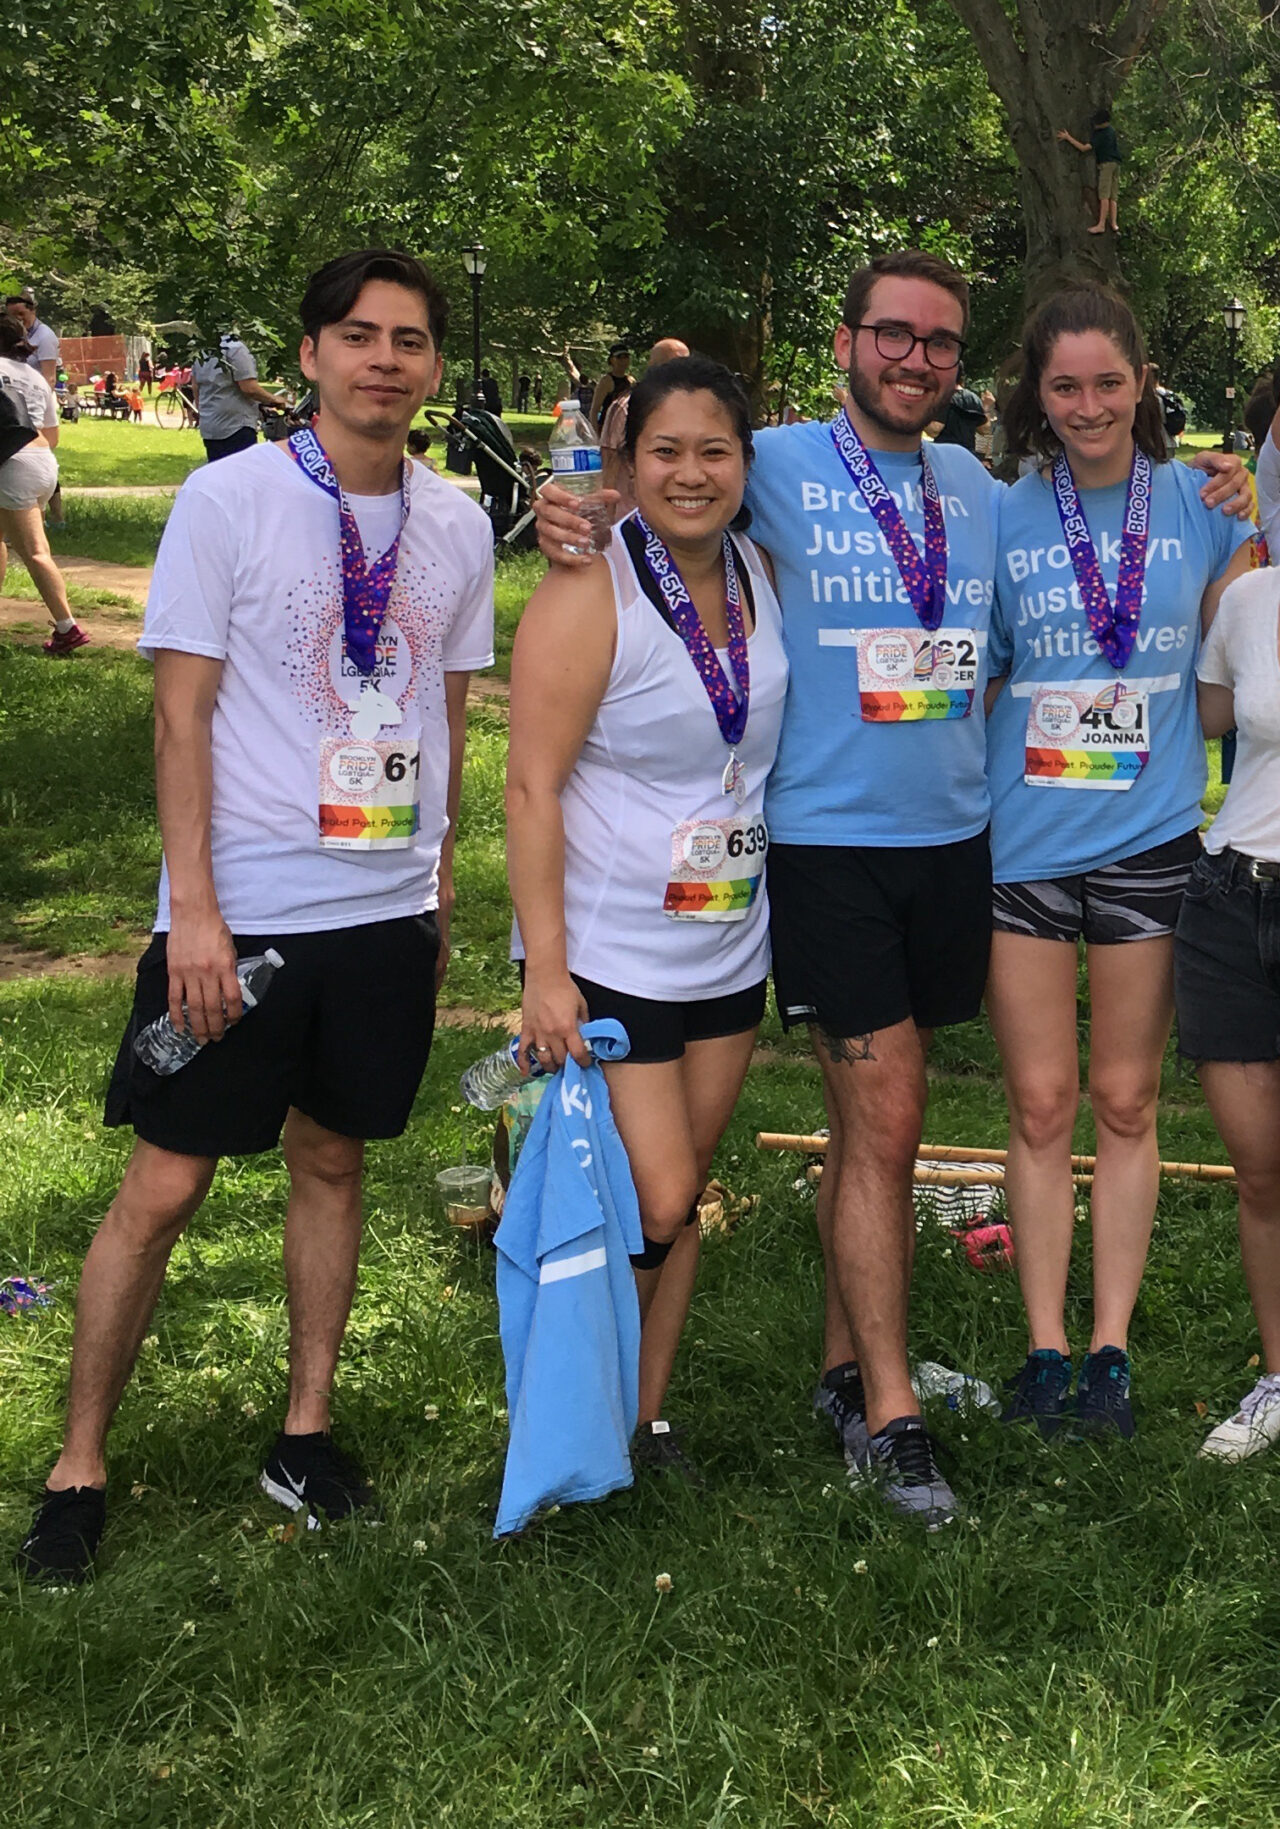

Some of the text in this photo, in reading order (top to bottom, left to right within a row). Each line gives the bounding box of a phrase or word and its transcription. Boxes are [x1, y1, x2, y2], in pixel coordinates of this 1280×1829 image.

[861, 476, 888, 505] 5K
[1067, 517, 1088, 545] 5K
[1006, 532, 1182, 583] Brokyn
[662, 576, 687, 607] 5K
[811, 566, 994, 606] Initiaves
[875, 648, 908, 658] PRIDE
[1042, 708, 1072, 719] PRIDE
[1082, 733, 1145, 744] JOANNA
[339, 760, 376, 772] PRIDE
[691, 839, 721, 850] PRIDE
[728, 824, 767, 858] 639
